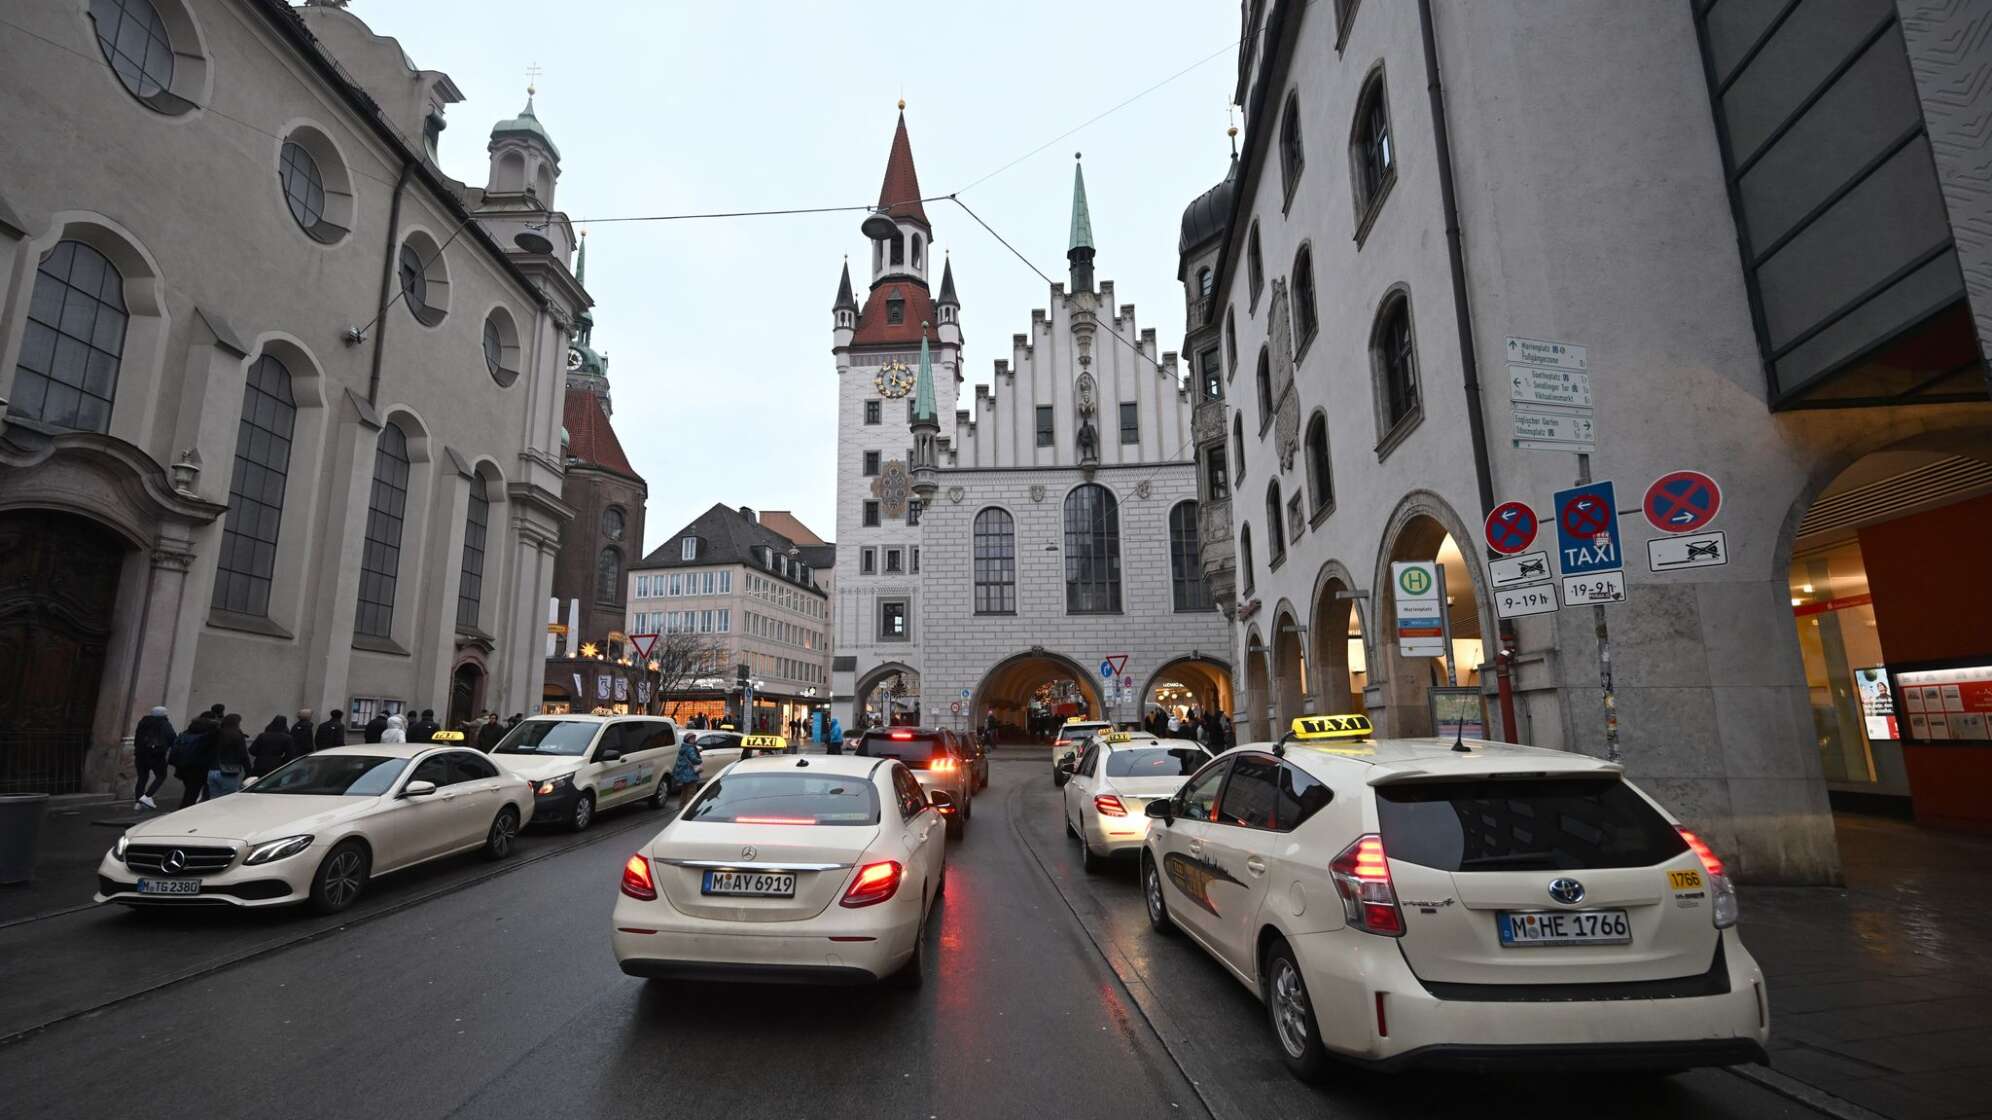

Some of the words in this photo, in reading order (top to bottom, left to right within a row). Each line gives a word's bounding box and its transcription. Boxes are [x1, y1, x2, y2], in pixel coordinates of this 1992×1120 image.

[1564, 543, 1616, 567] TAXI
[1408, 572, 1422, 589] H
[1539, 592, 1548, 605] h
[1308, 717, 1362, 731] TAXI
[749, 737, 777, 746] TAXI
[143, 881, 150, 892] M
[155, 881, 169, 892] TG
[170, 881, 198, 893] 2380
[713, 874, 724, 889] M
[732, 875, 753, 890] AY
[755, 875, 793, 892] 6919
[1671, 871, 1701, 887] 1766
[1511, 917, 1528, 937] M
[1539, 916, 1568, 937] HE
[1573, 914, 1627, 936] 1766
